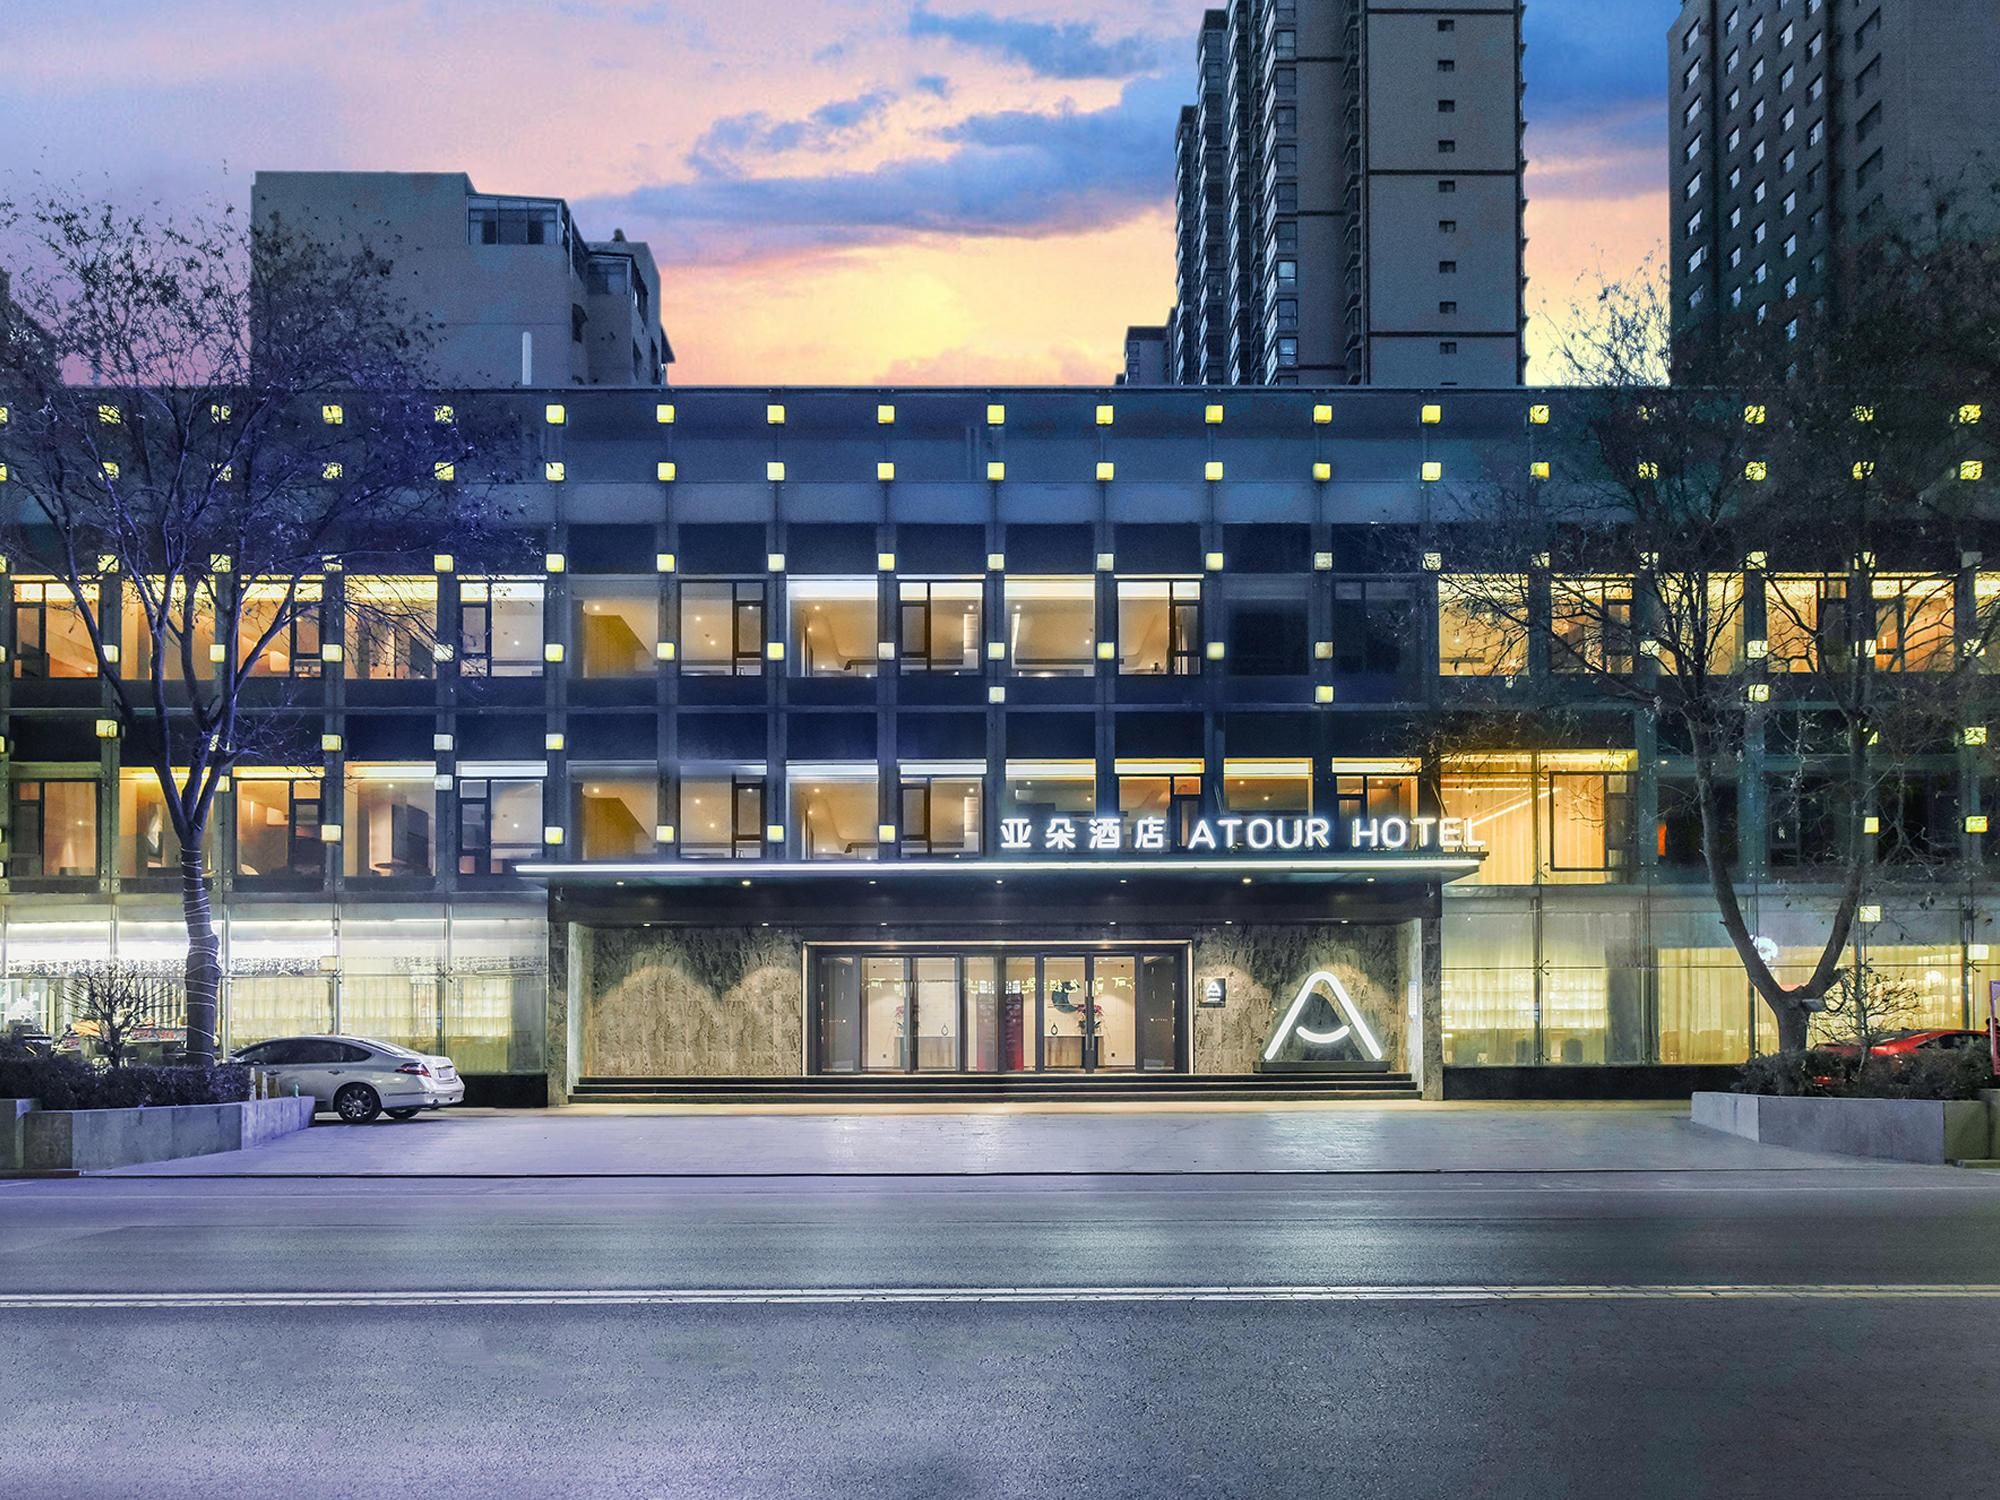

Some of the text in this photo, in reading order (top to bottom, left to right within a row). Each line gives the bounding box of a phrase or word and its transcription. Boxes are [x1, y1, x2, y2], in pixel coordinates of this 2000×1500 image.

[1000, 816, 1165, 849] 亚朵酒店
[1188, 818, 1486, 849] ATOUR HOTEL
